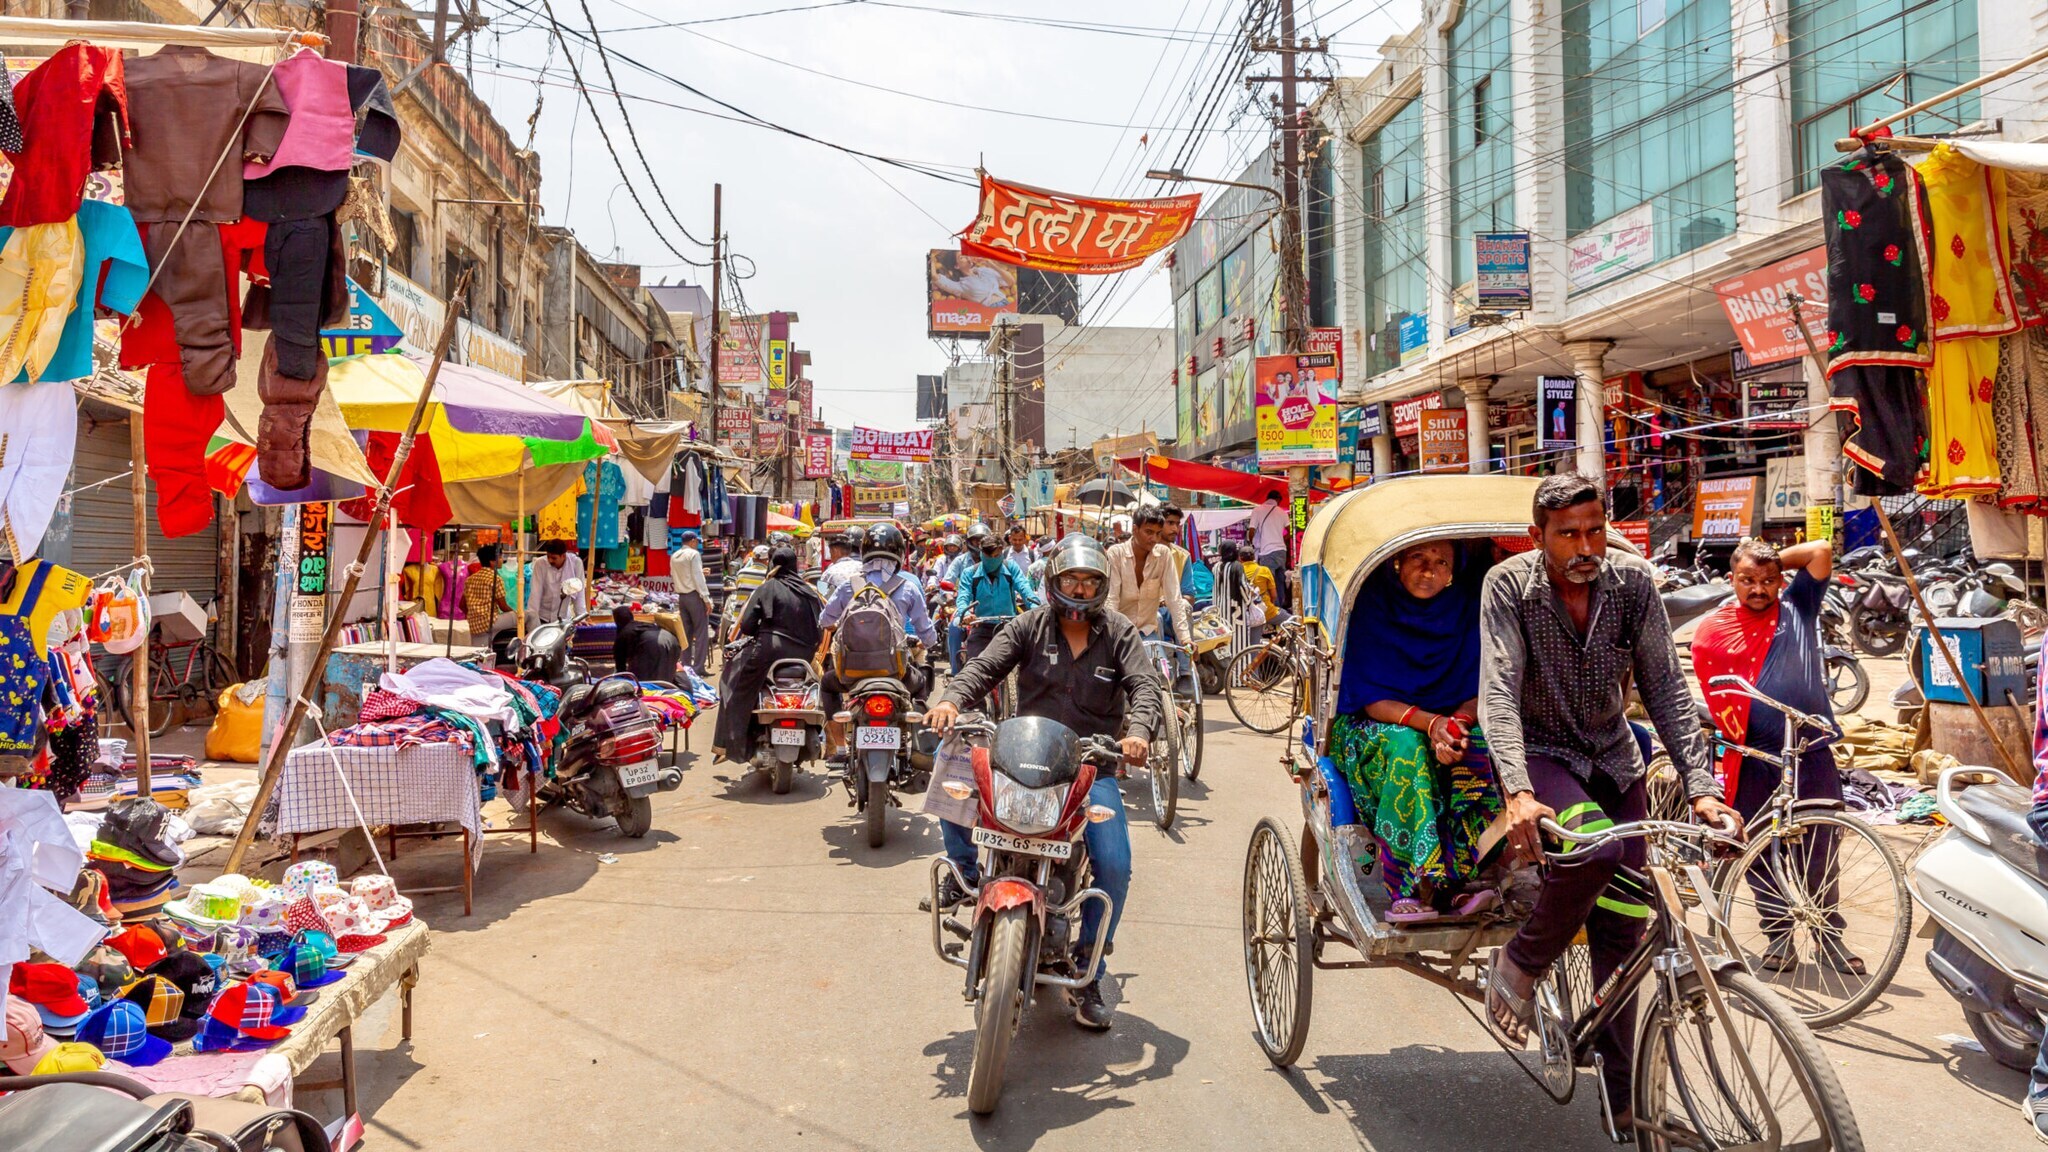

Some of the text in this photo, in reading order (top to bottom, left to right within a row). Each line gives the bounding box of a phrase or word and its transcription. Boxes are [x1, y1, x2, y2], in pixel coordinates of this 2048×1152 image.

[1477, 239, 1526, 252] BHARAT
[1477, 252, 1526, 265] SPORTS
[1725, 278, 1799, 324] BHARAT
[936, 311, 982, 326] maaza
[1310, 342, 1337, 352] LINE
[1310, 354, 1331, 364] mart
[1544, 379, 1576, 390] BOMBAY
[1546, 389, 1574, 400] STYLEZ
[1750, 387, 1778, 400] Sport
[1281, 403, 1309, 416] HOLI
[1394, 400, 1423, 424] SPORTS
[1428, 418, 1460, 429] SHIV
[853, 428, 932, 448] BOMBAY
[1423, 429, 1466, 441] SPORTS
[810, 437, 827, 468] BOMBAY
[852, 445, 875, 453] FASHION
[896, 447, 931, 456] COLLECTION
[807, 468, 830, 476] SALE
[1701, 478, 1752, 494] BHARAT SPORTS
[862, 733, 896, 744] 0245
[1019, 763, 1051, 771] HONDA
[1935, 889, 1989, 920] Activa
